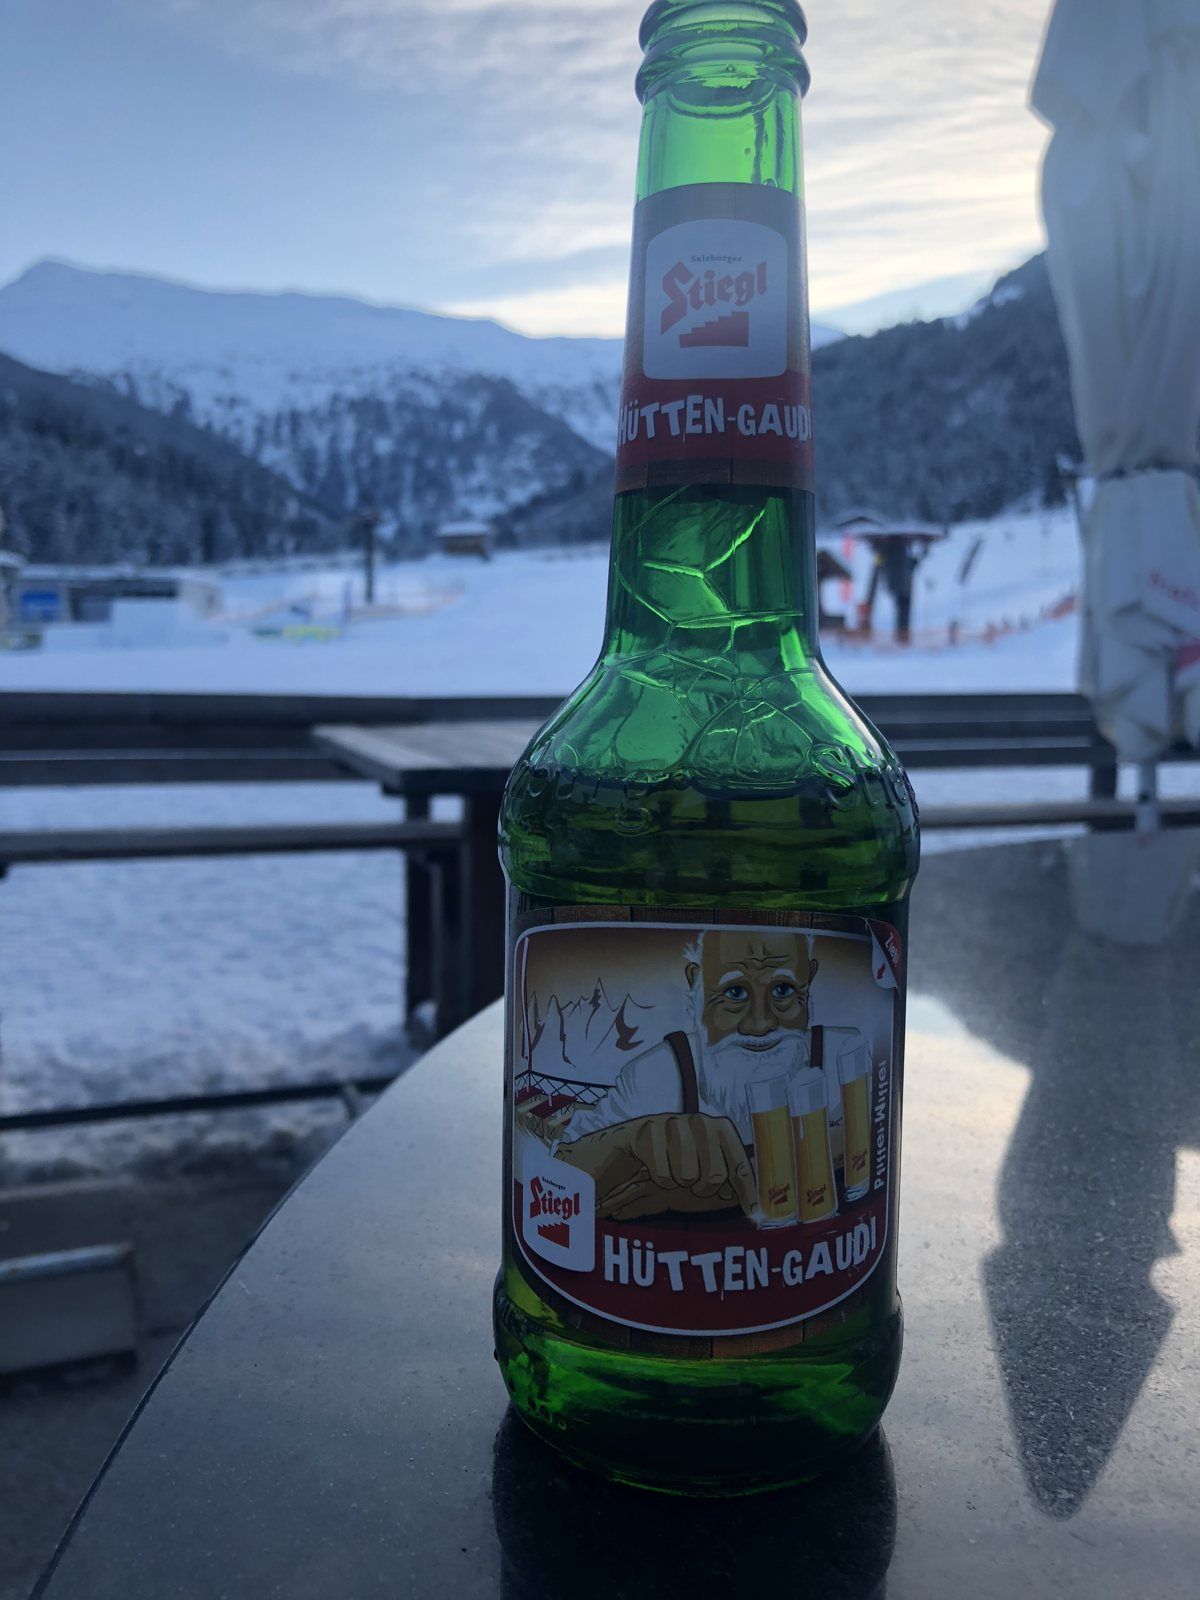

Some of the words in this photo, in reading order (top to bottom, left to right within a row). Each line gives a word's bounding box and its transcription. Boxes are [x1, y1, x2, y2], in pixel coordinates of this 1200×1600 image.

[660, 261, 768, 336] Stiegl
[529, 1176, 581, 1221] Stiegl
[603, 1216, 878, 1293] HÜTTEN-GAUDI
